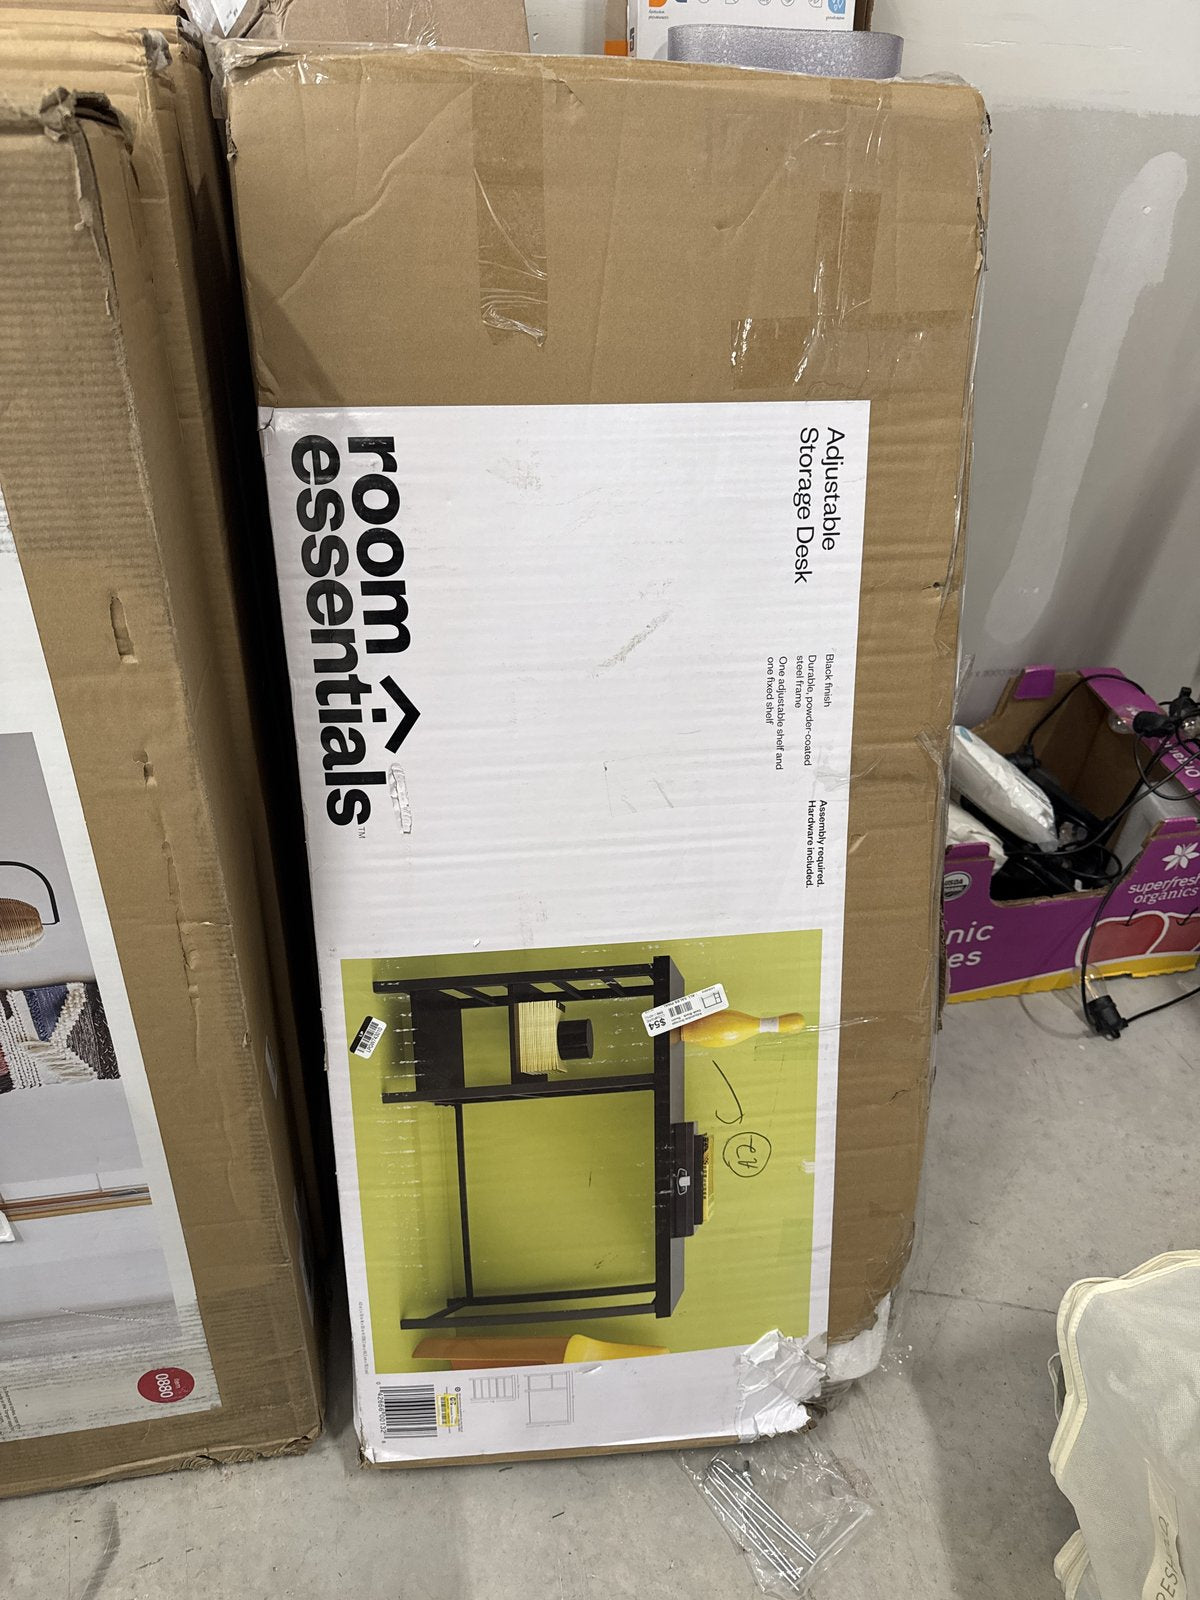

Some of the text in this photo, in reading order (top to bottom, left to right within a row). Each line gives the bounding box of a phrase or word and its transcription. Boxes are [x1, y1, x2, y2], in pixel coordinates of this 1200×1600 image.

[793, 427, 819, 584] Storage Desk
[821, 427, 845, 551] Adjustable
[347, 436, 413, 654] room
[290, 434, 387, 826] essentials
[765, 701, 774, 725] shelf
[766, 677, 776, 700] fixed
[775, 656, 788, 770] One adjustable shelf and
[794, 655, 805, 708] steel frame
[803, 655, 817, 766] Durable, powder-coated
[823, 653, 834, 708] Black finish
[805, 800, 817, 888] Hardware included.
[816, 799, 828, 888] Assembly required.
[1133, 887, 1199, 905] organics
[648, 1017, 666, 1030] $54
[155, 1373, 174, 1398] 0880
